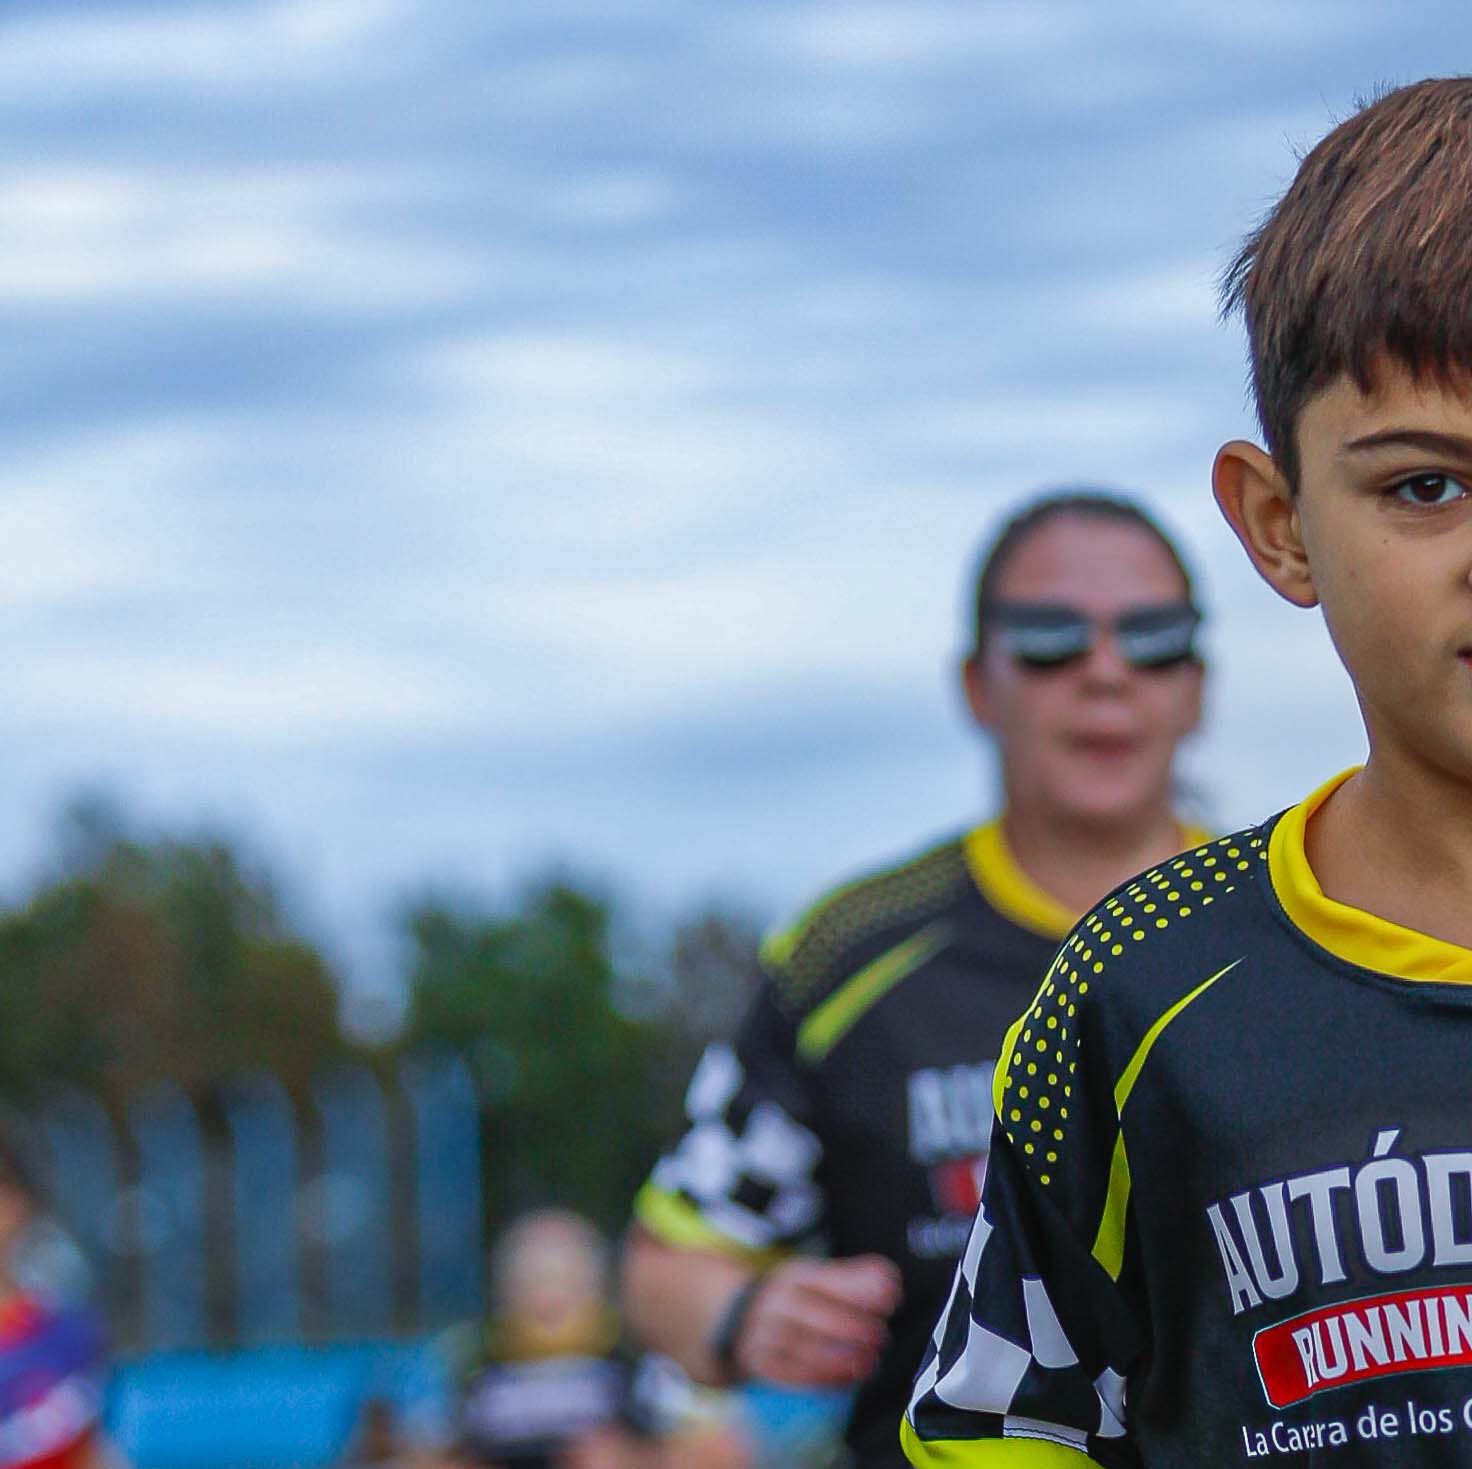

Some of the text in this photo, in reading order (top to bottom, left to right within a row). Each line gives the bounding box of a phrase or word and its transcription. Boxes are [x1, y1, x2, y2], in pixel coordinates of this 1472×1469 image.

[1242, 1425, 1270, 1458] La
[1357, 1404, 1399, 1440] de
[1407, 1400, 1454, 1435] los
